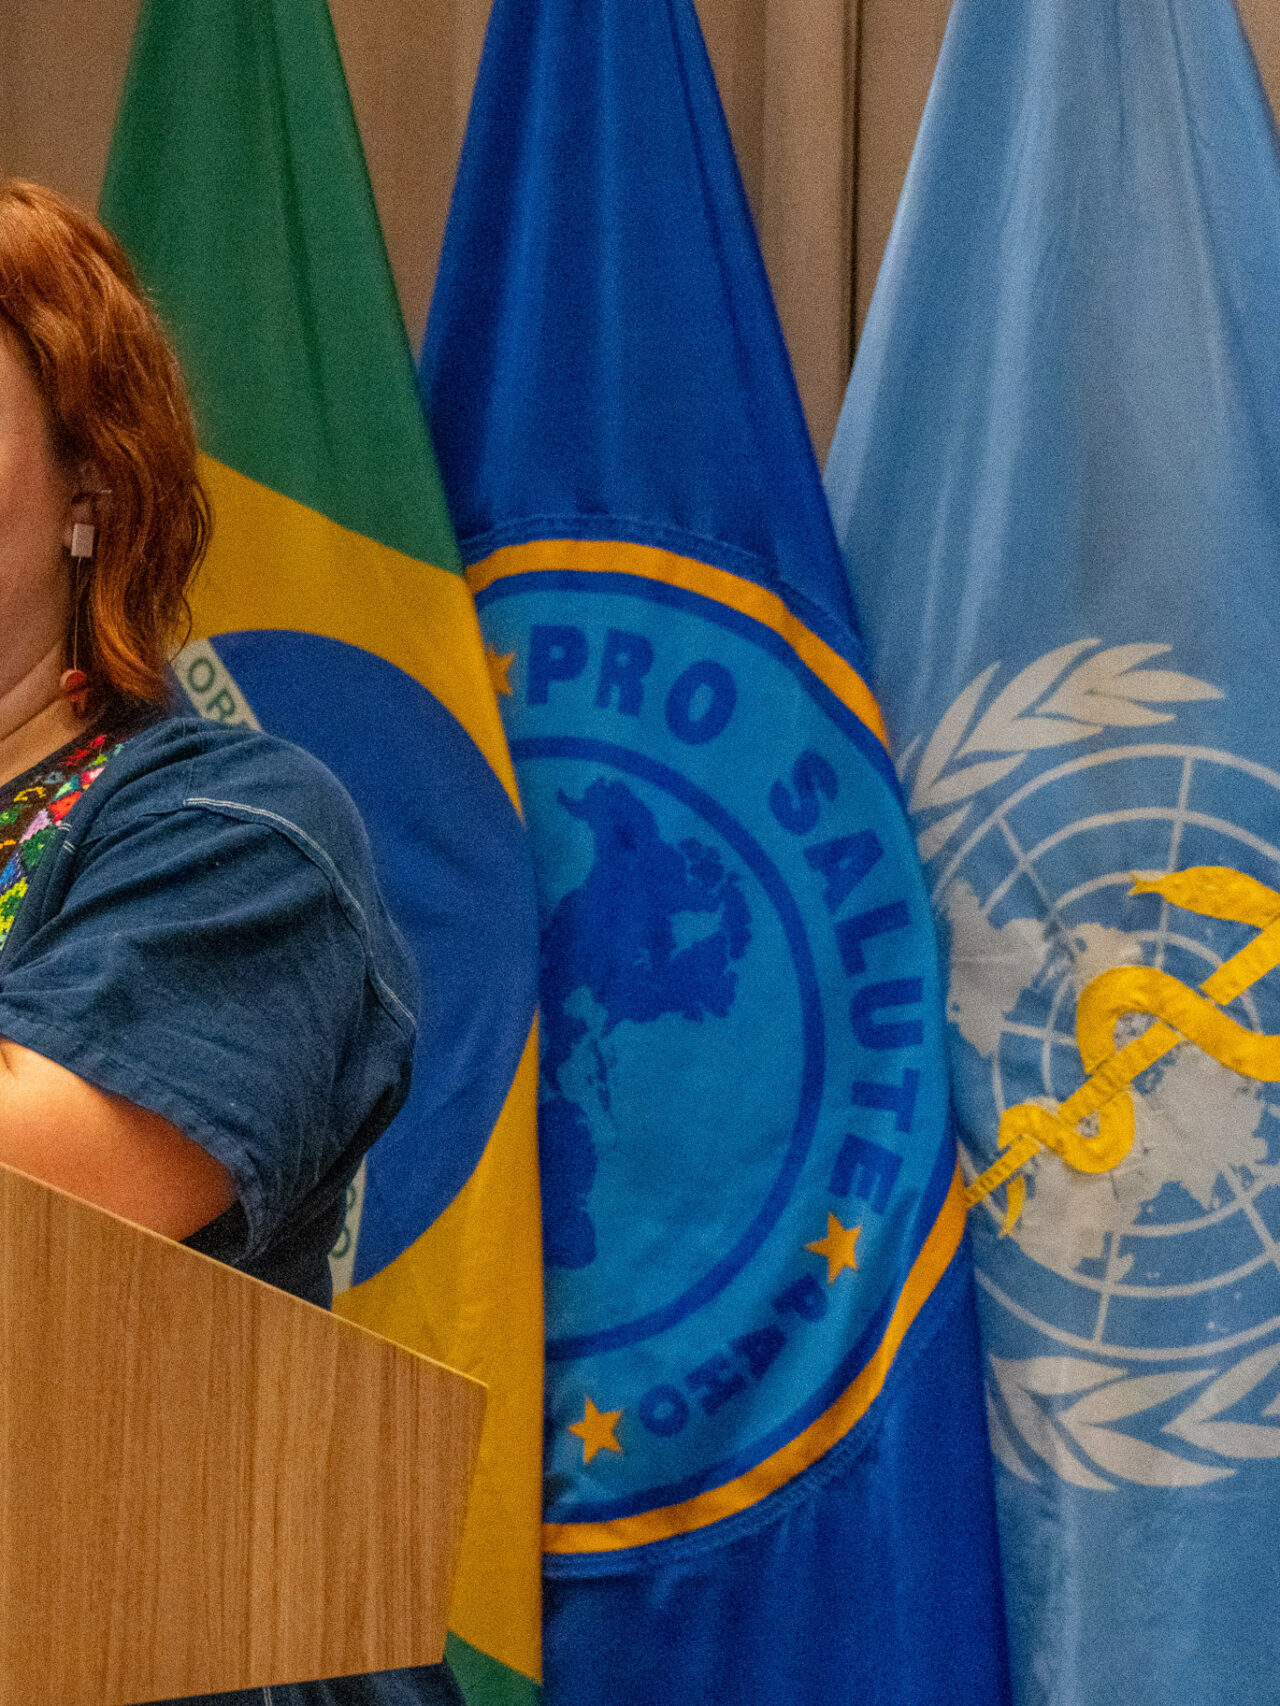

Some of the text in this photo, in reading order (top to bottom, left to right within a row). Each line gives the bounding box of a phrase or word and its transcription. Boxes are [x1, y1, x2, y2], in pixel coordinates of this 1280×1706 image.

[187, 657, 237, 722] OR
[527, 624, 925, 1216] PRO SALUTE
[638, 1273, 828, 1438] PAHO
